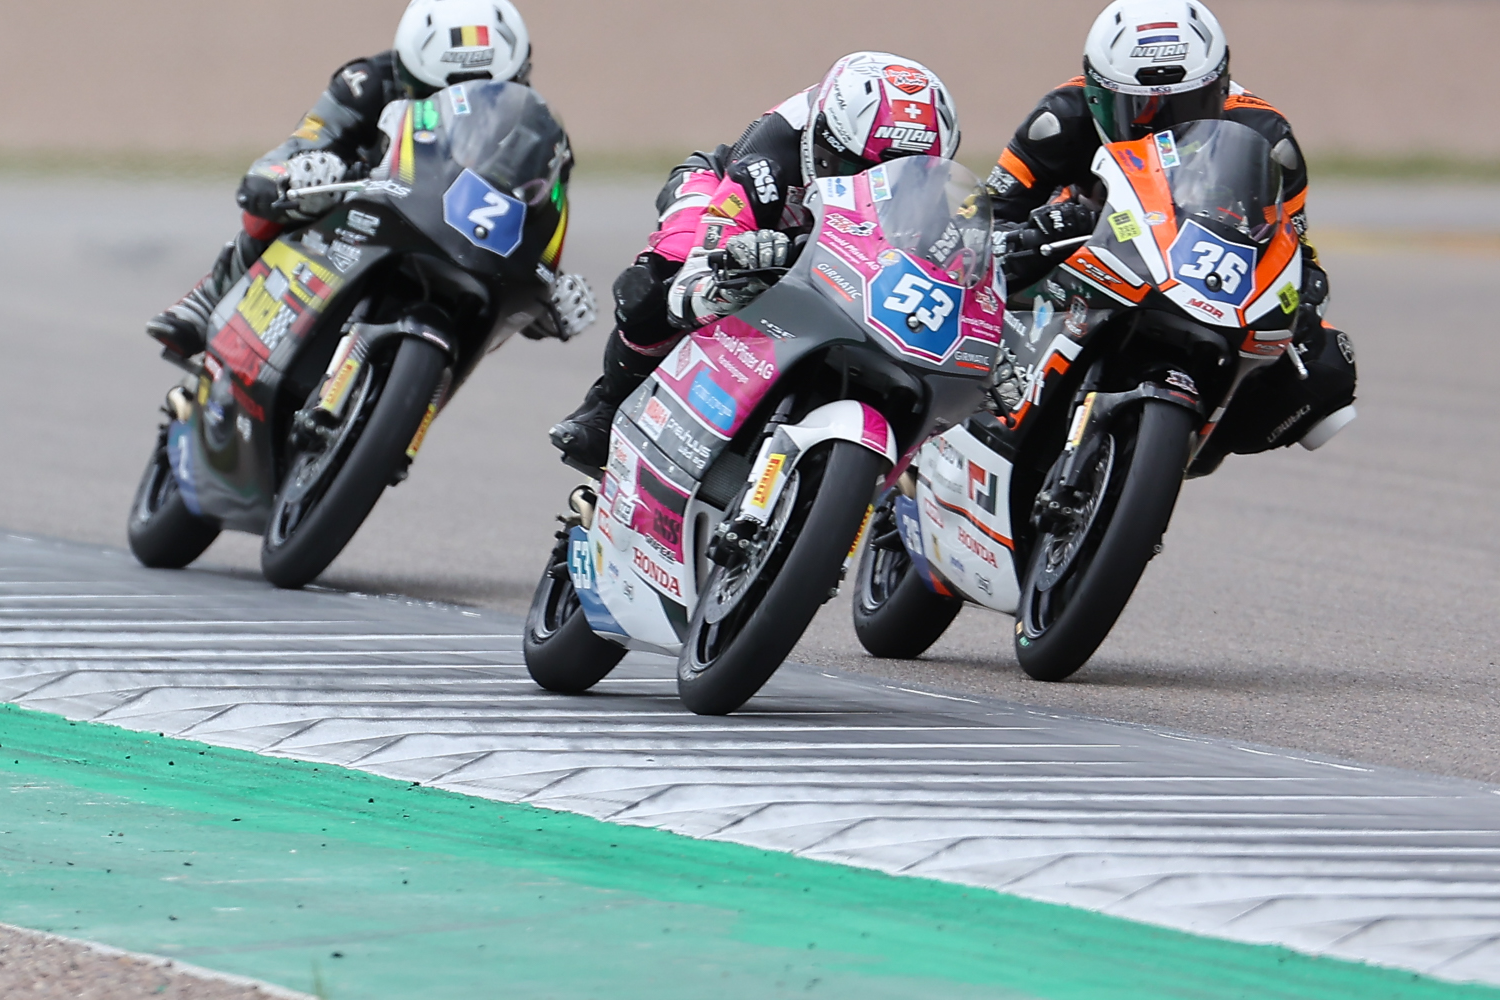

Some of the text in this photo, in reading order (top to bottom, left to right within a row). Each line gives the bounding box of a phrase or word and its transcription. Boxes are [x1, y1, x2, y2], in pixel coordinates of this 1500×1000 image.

[1130, 43, 1189, 62] NOLAN
[874, 126, 937, 150] NOLAN
[467, 192, 510, 231] 2
[817, 262, 862, 300] GIRMATIC
[1179, 241, 1248, 294] 36
[883, 273, 954, 332] 53
[754, 360, 775, 380] AG
[573, 540, 592, 589] 53
[958, 526, 999, 569] HONDA
[633, 546, 682, 598] HONDA
